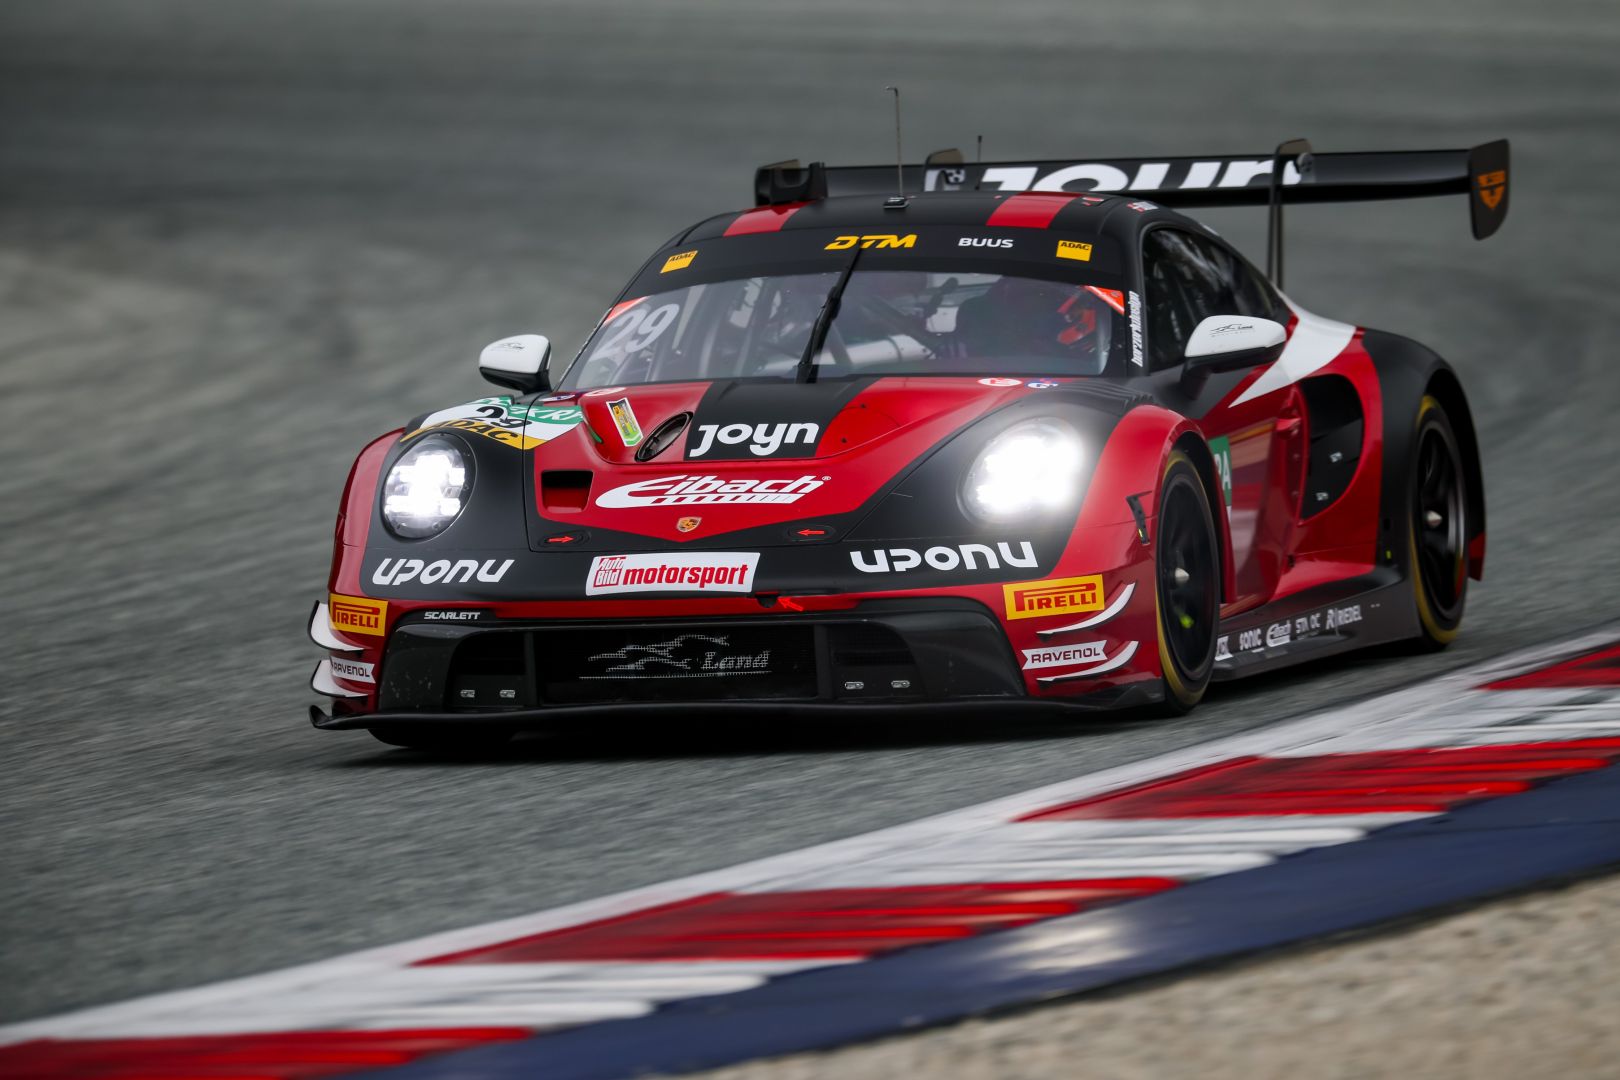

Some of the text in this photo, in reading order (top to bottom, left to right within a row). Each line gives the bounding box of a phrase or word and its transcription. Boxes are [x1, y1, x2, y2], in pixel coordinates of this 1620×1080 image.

[824, 234, 917, 249] DTM
[957, 237, 1014, 249] BUUS
[1060, 241, 1090, 251] ADAC
[588, 303, 680, 361] 29
[461, 405, 533, 429] 29
[594, 564, 749, 589] Bild motorsport
[1015, 582, 1098, 612] PIRELLI
[332, 601, 381, 630] PIRELLI
[423, 611, 481, 620] SCARLETT
[1030, 647, 1102, 665] RAVENOL
[333, 662, 371, 678] RAVENOL
